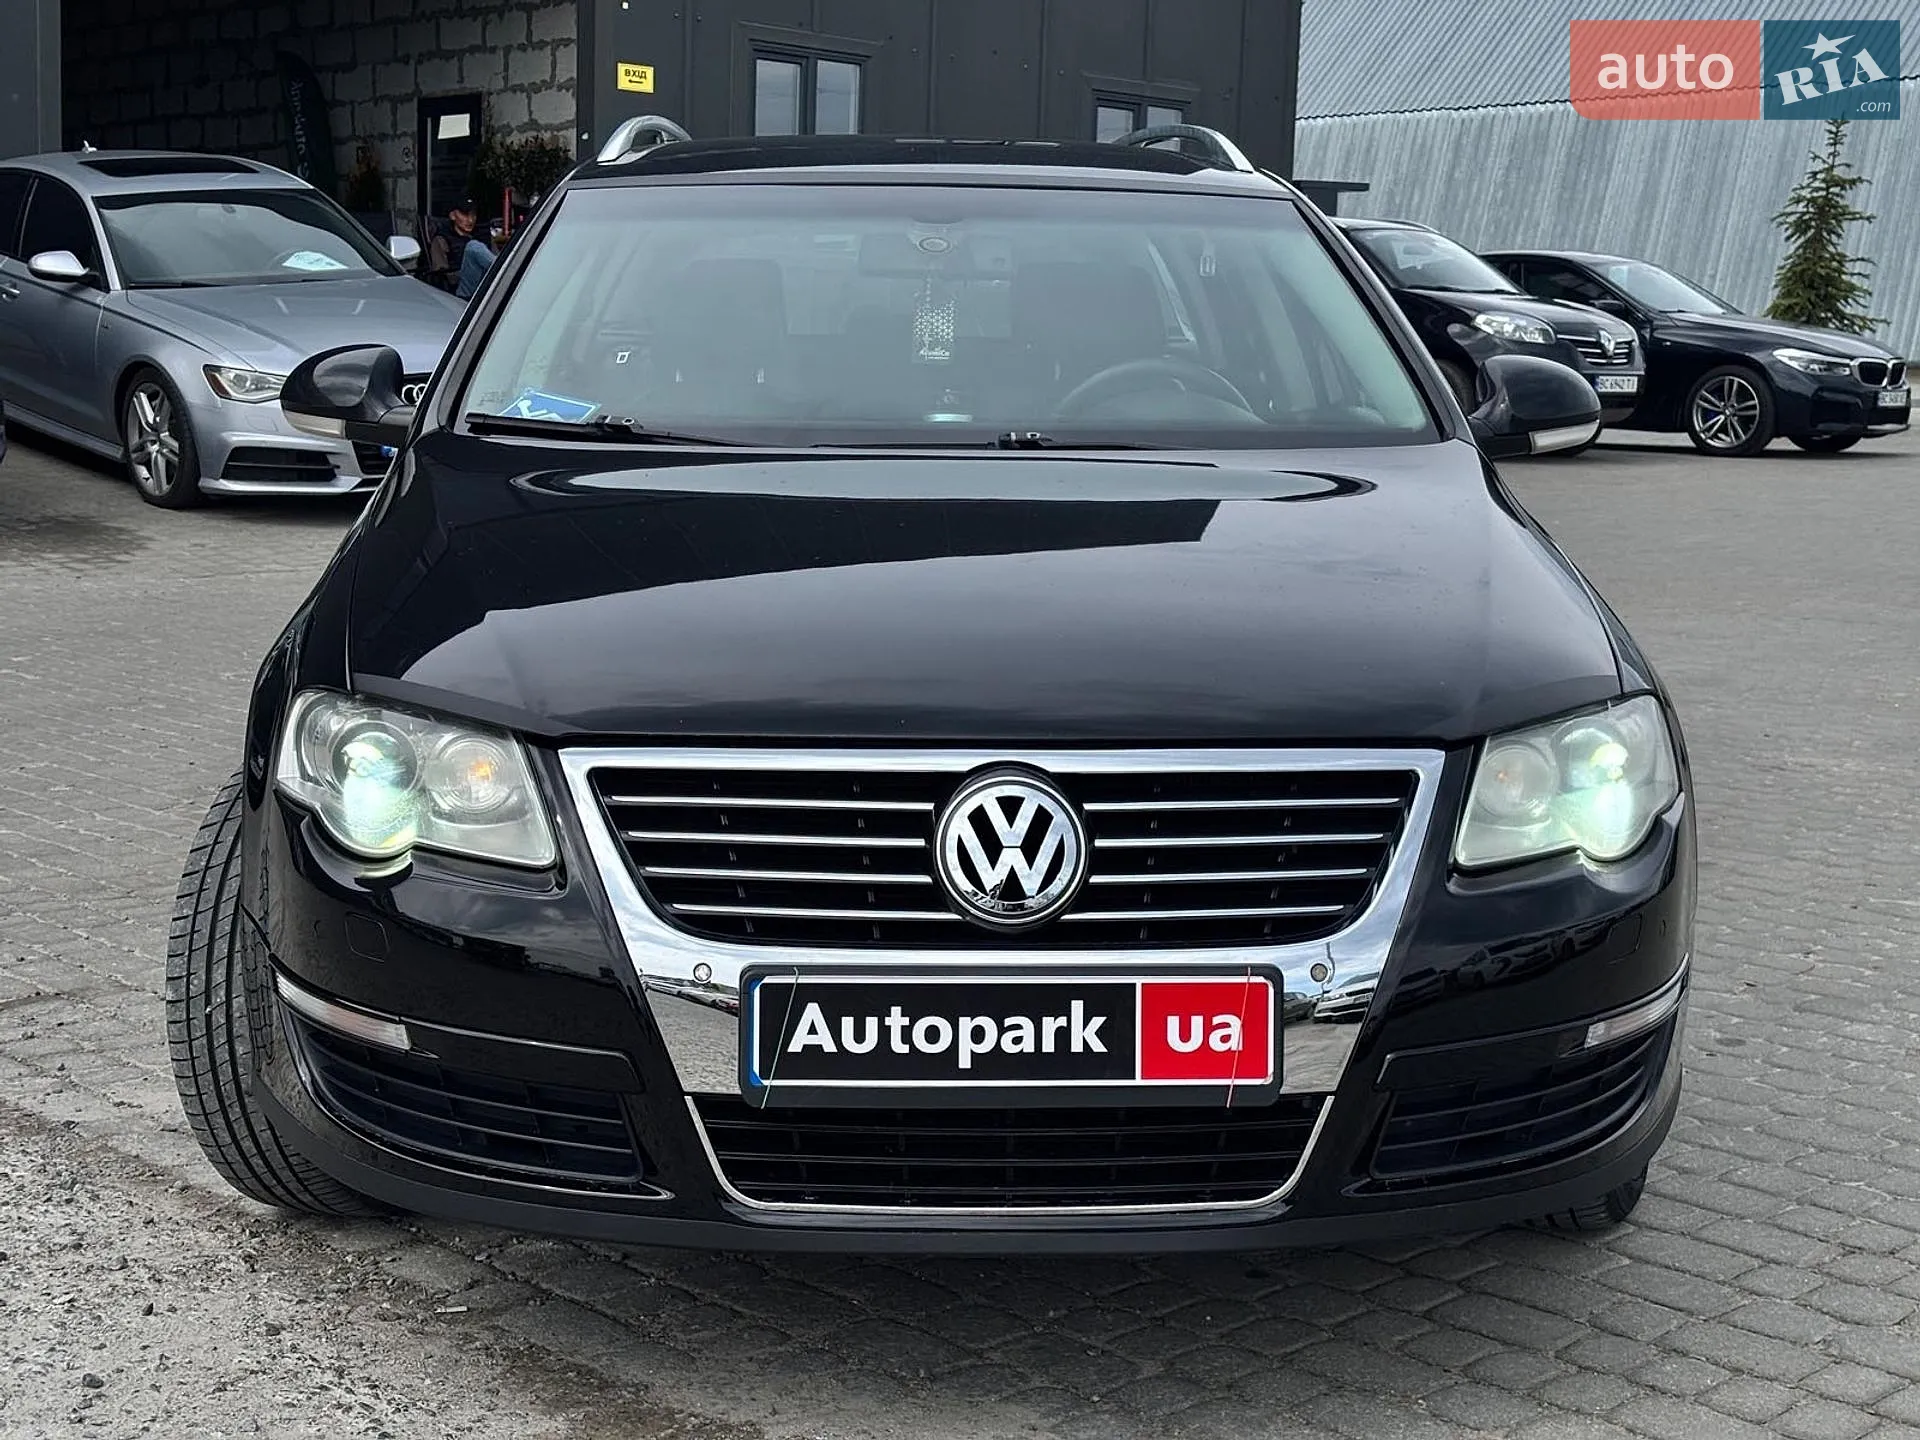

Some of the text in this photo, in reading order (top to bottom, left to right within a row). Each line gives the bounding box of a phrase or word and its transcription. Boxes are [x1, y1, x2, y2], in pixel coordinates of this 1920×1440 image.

[624, 68, 647, 80] ВХІД
[787, 1000, 1244, 1069] Autopark ua
